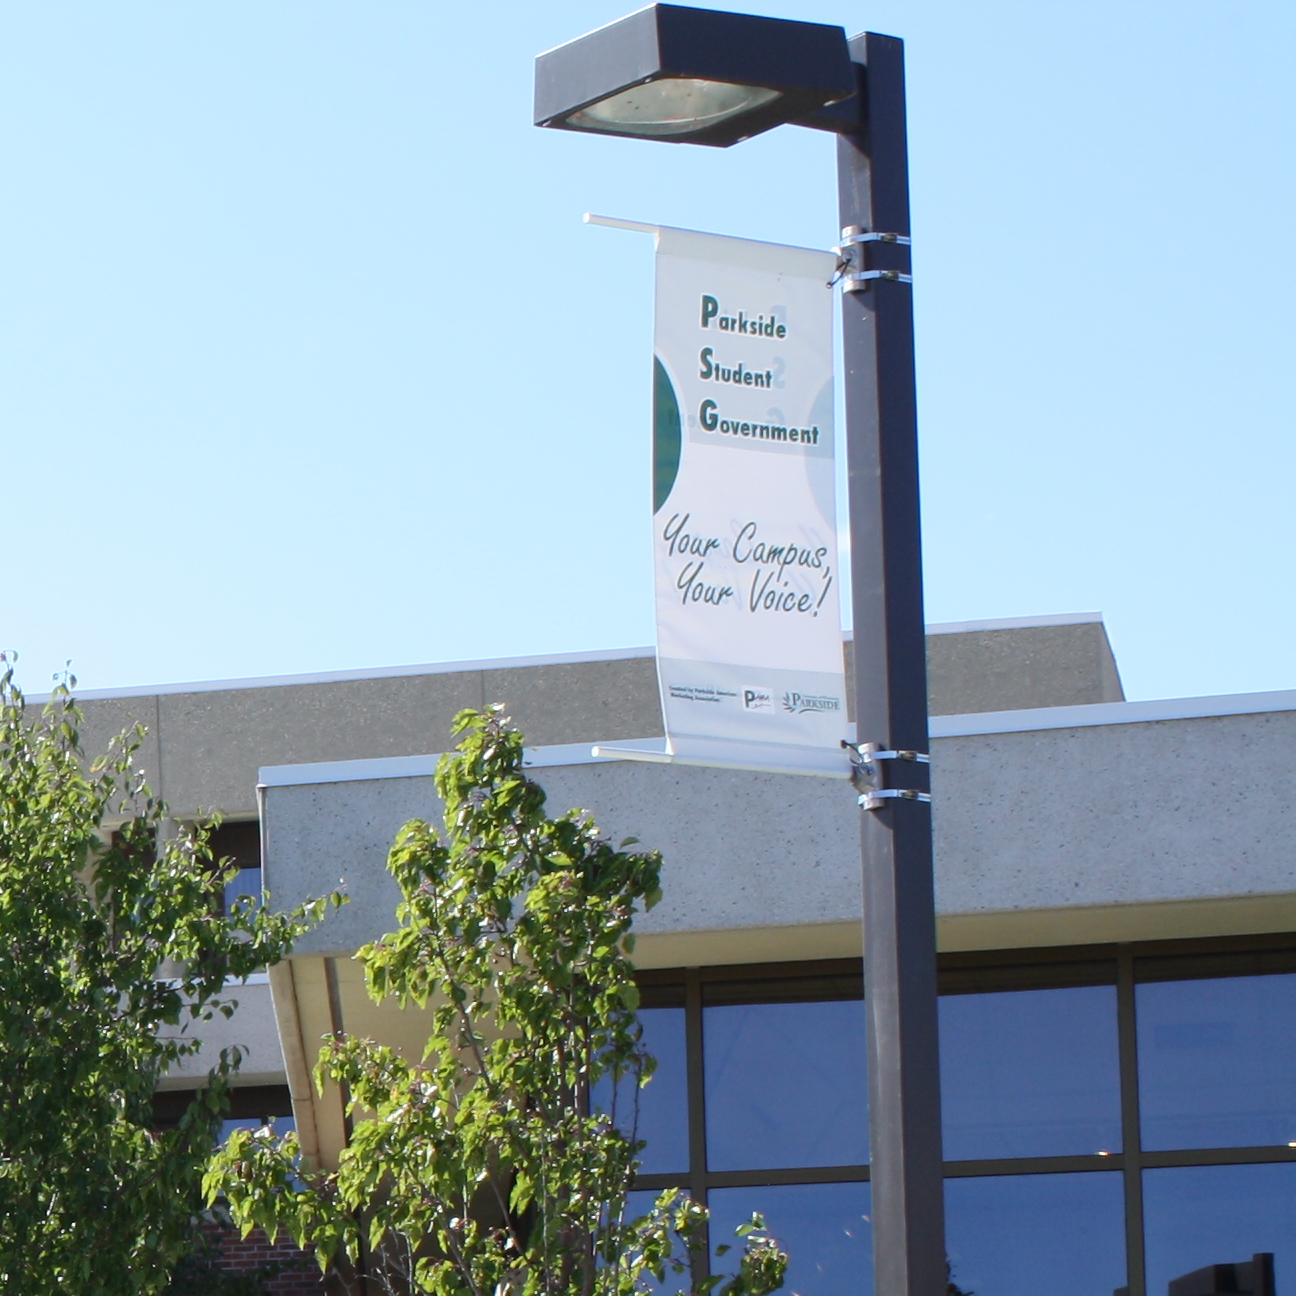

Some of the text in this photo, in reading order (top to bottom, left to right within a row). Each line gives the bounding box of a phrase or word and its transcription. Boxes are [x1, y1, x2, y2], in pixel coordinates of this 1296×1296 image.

[700, 294, 787, 340] Parkside
[698, 347, 773, 390] Student
[699, 399, 820, 446] Government
[663, 512, 832, 584] Your Campus,
[676, 561, 833, 618] Your Voice!
